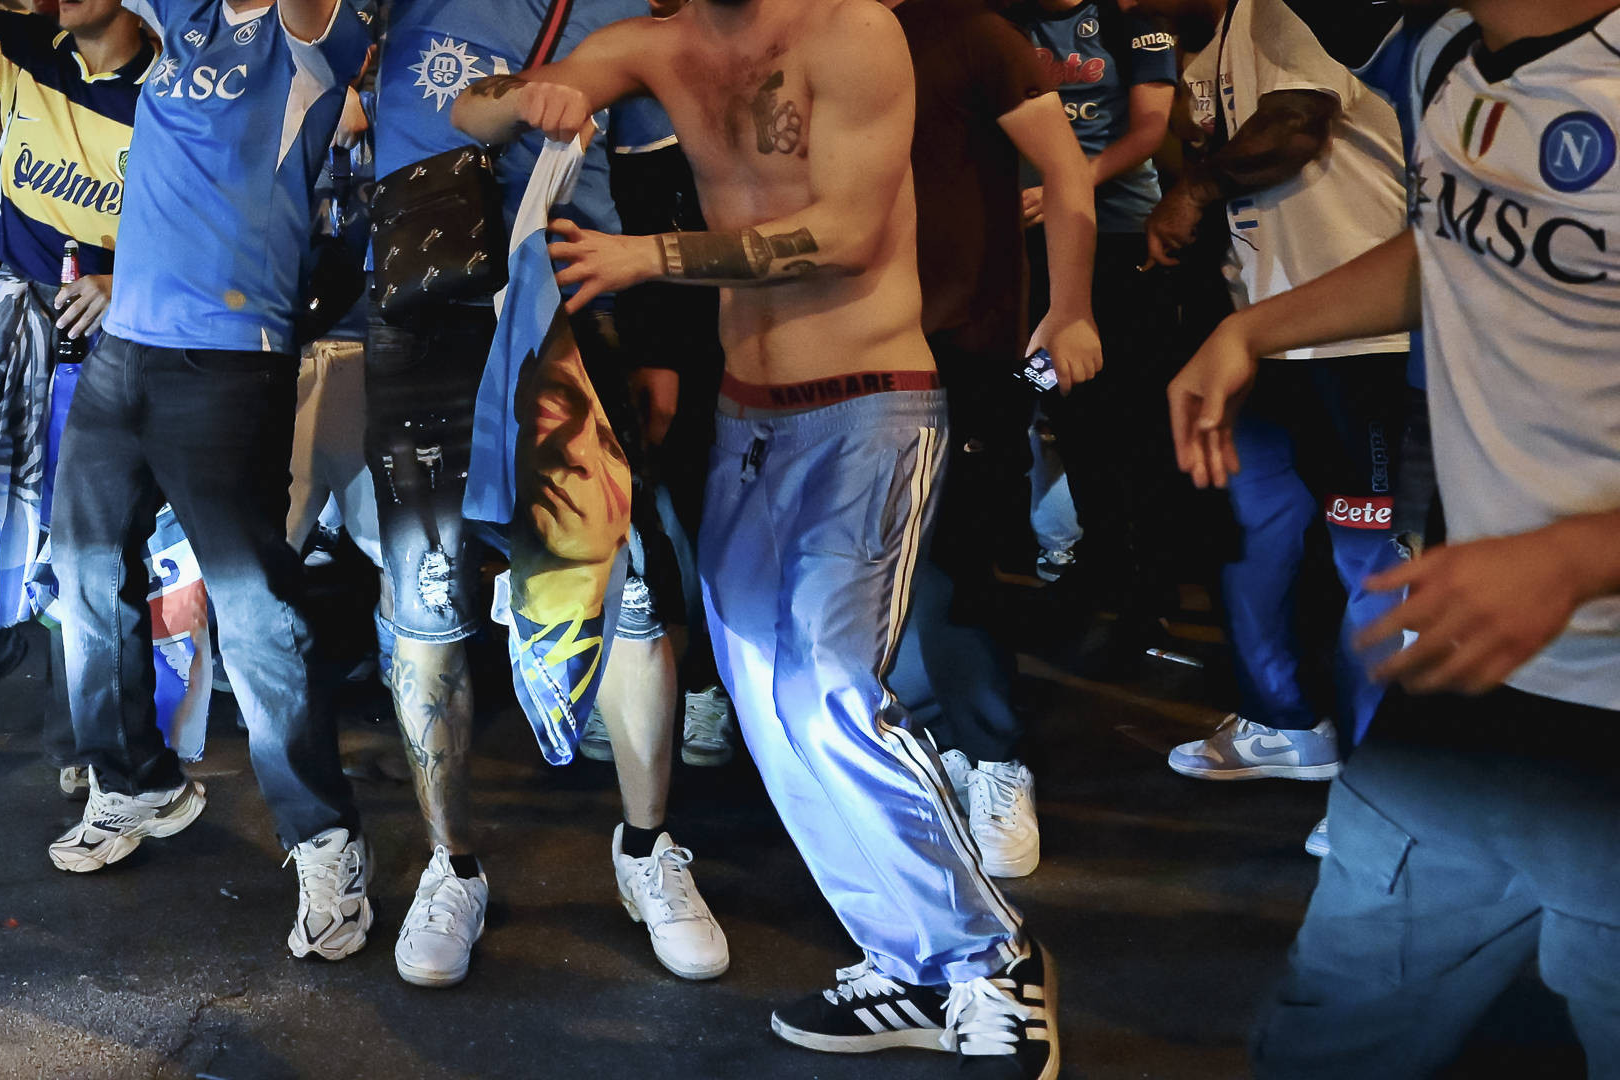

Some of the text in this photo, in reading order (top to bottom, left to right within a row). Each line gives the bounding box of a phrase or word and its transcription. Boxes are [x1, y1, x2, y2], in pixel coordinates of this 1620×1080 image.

[1082, 20, 1095, 34] N
[1553, 129, 1592, 172] N
[1435, 172, 1608, 284] MSC
[1326, 498, 1392, 523] Lete
